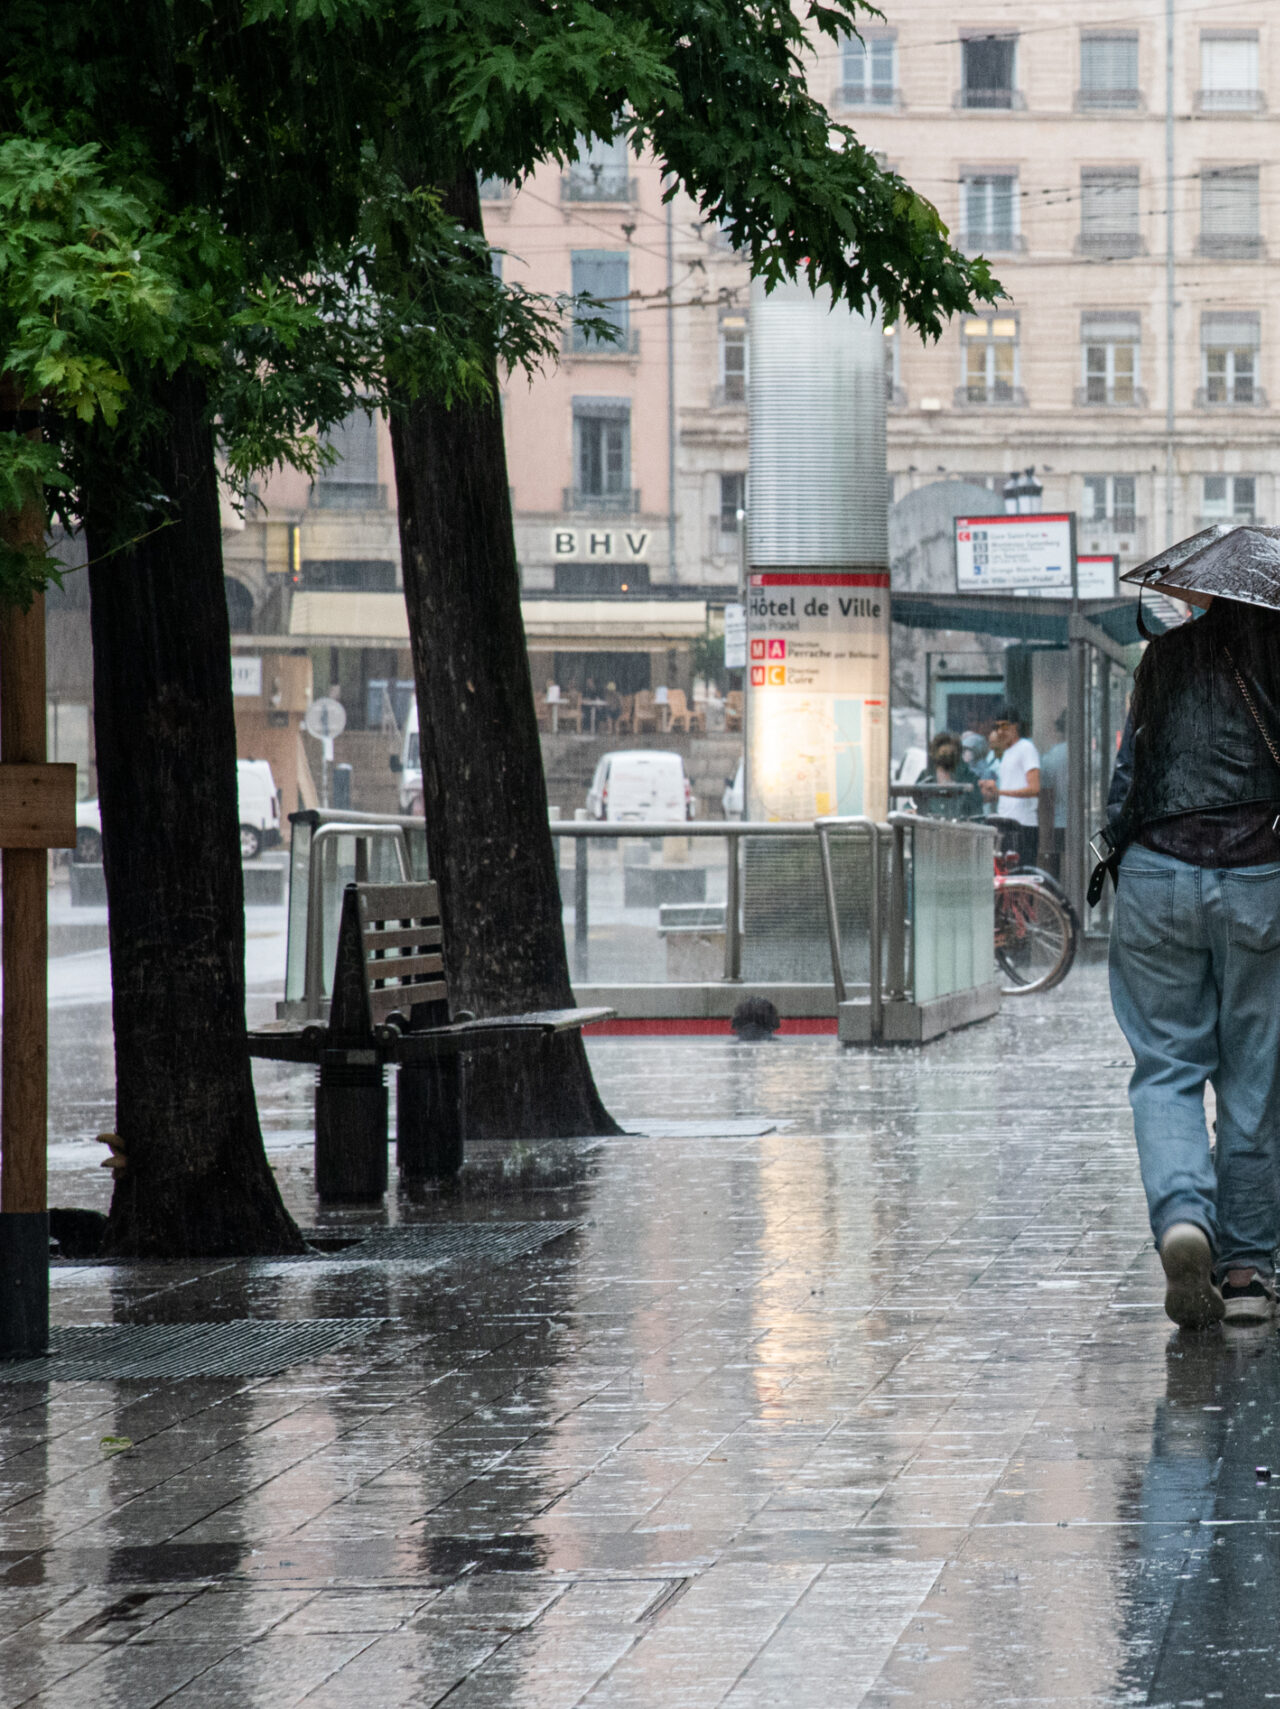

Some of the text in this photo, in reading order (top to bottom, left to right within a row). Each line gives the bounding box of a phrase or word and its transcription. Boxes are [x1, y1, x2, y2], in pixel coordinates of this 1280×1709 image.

[555, 532, 648, 555] BHV
[750, 597, 881, 618] Hôtel de Ville
[752, 641, 784, 659] M A
[788, 650, 831, 659] Perrache
[752, 667, 783, 685] M C
